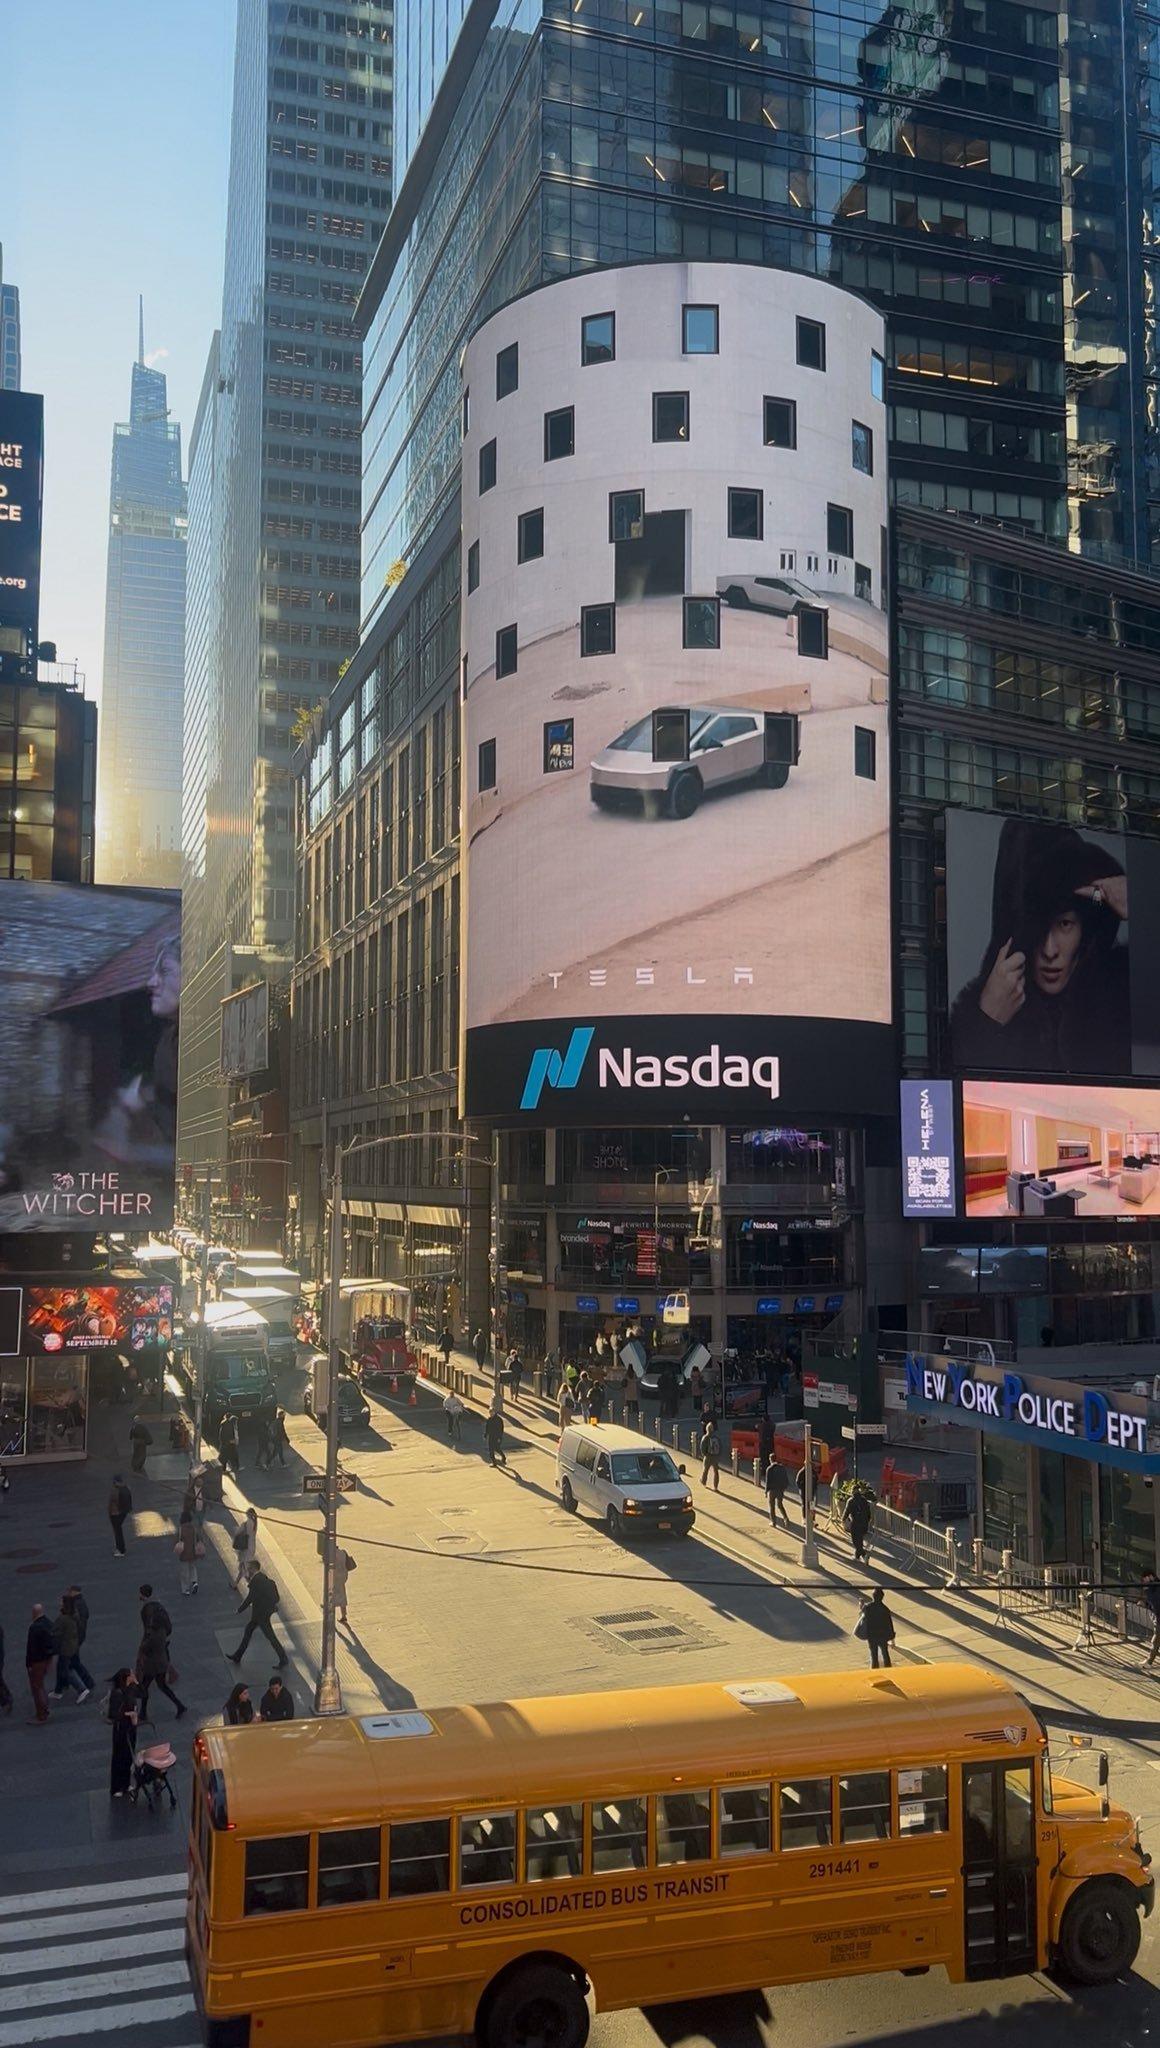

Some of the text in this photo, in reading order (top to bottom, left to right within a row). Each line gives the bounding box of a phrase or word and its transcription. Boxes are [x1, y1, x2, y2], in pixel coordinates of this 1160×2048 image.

[548, 967, 754, 989] TESLA
[599, 1044, 780, 1100] Nasdaq
[920, 1088, 930, 1150] HELENA
[78, 1172, 119, 1190] THE
[22, 1193, 152, 1216] WITCHER
[587, 1220, 611, 1229] Nasdaq
[753, 1222, 778, 1230] Nasdaq
[905, 1353, 946, 1401] NEW
[948, 1362, 1000, 1417] YORK
[1003, 1372, 1075, 1436] POLICE
[1084, 1390, 1147, 1453] DEPT
[809, 1859, 860, 1878] 291441
[460, 1874, 730, 1925] CONSOLIDATED BUS TRANSIT
